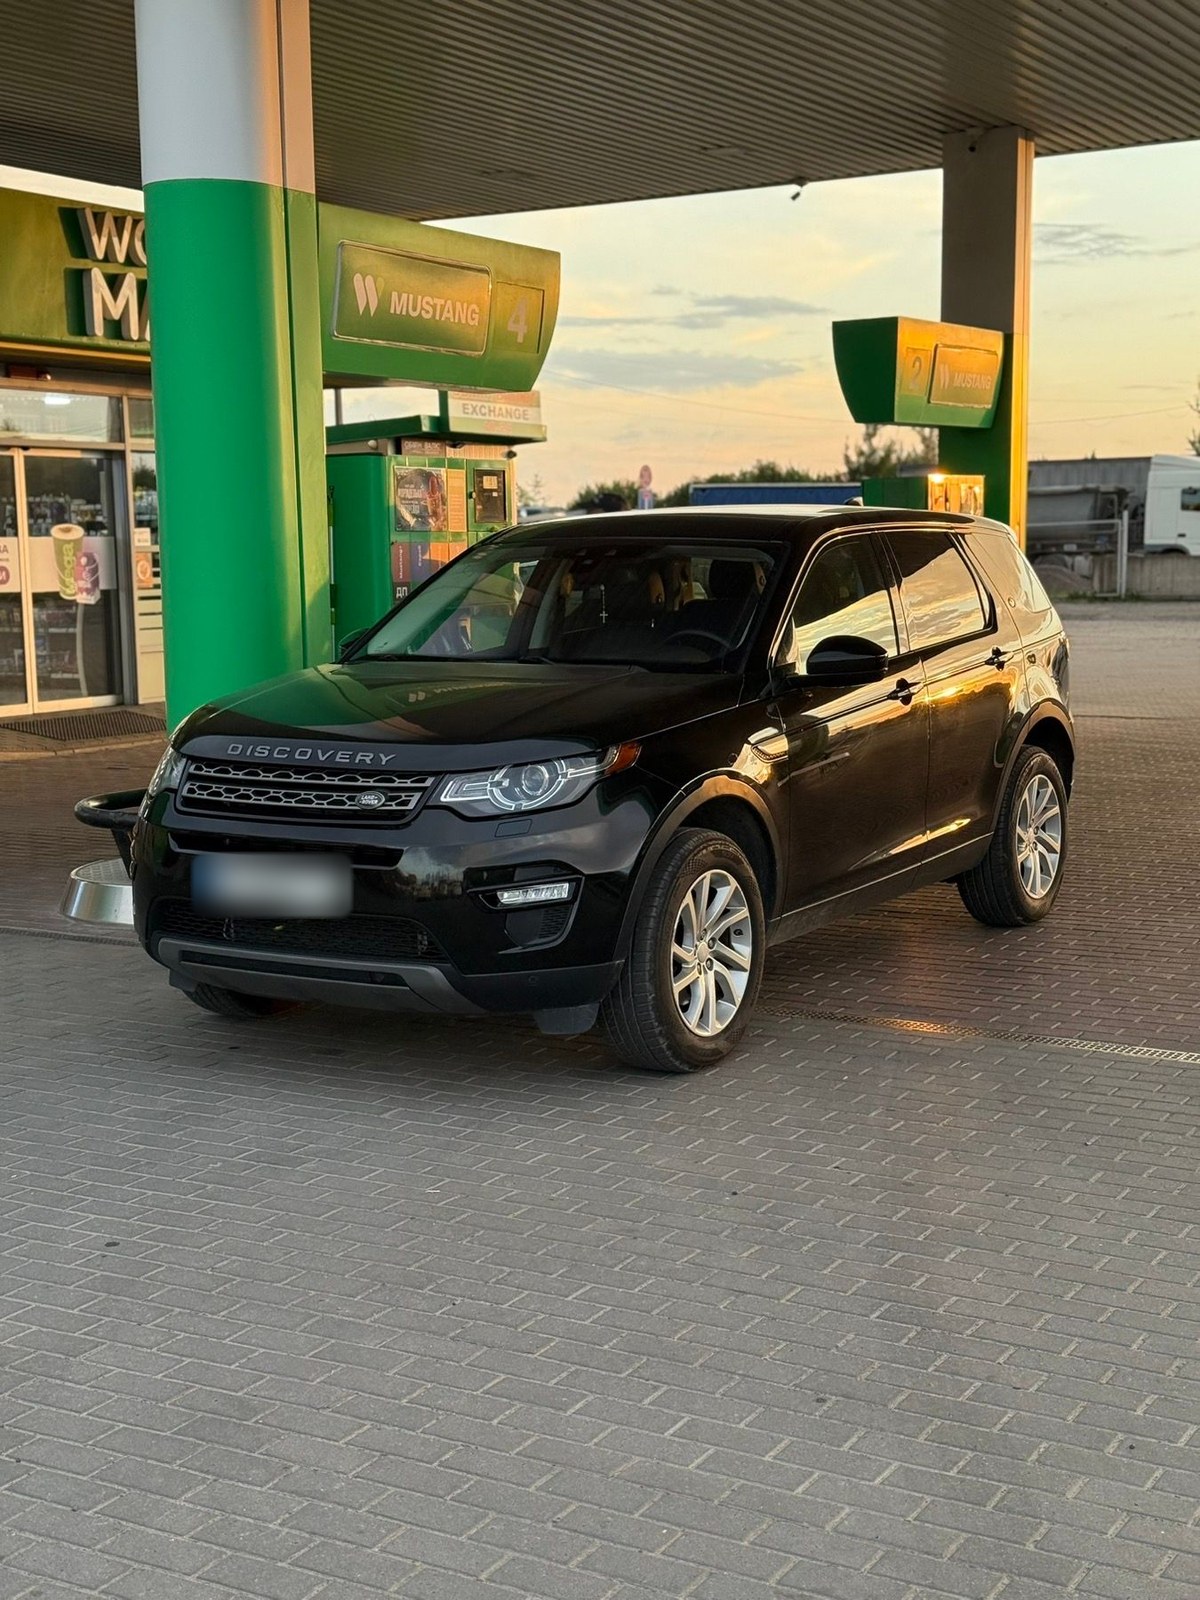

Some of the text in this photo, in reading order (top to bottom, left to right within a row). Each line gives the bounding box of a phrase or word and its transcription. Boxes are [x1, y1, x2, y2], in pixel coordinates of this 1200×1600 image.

[91, 267, 150, 341] M
[390, 291, 479, 326] MUSTANG
[507, 296, 528, 343] 4
[910, 356, 922, 390] 2
[953, 373, 992, 389] MUSTANG
[461, 402, 530, 421] EXCHANGE
[226, 743, 396, 766] DISCOVERY
